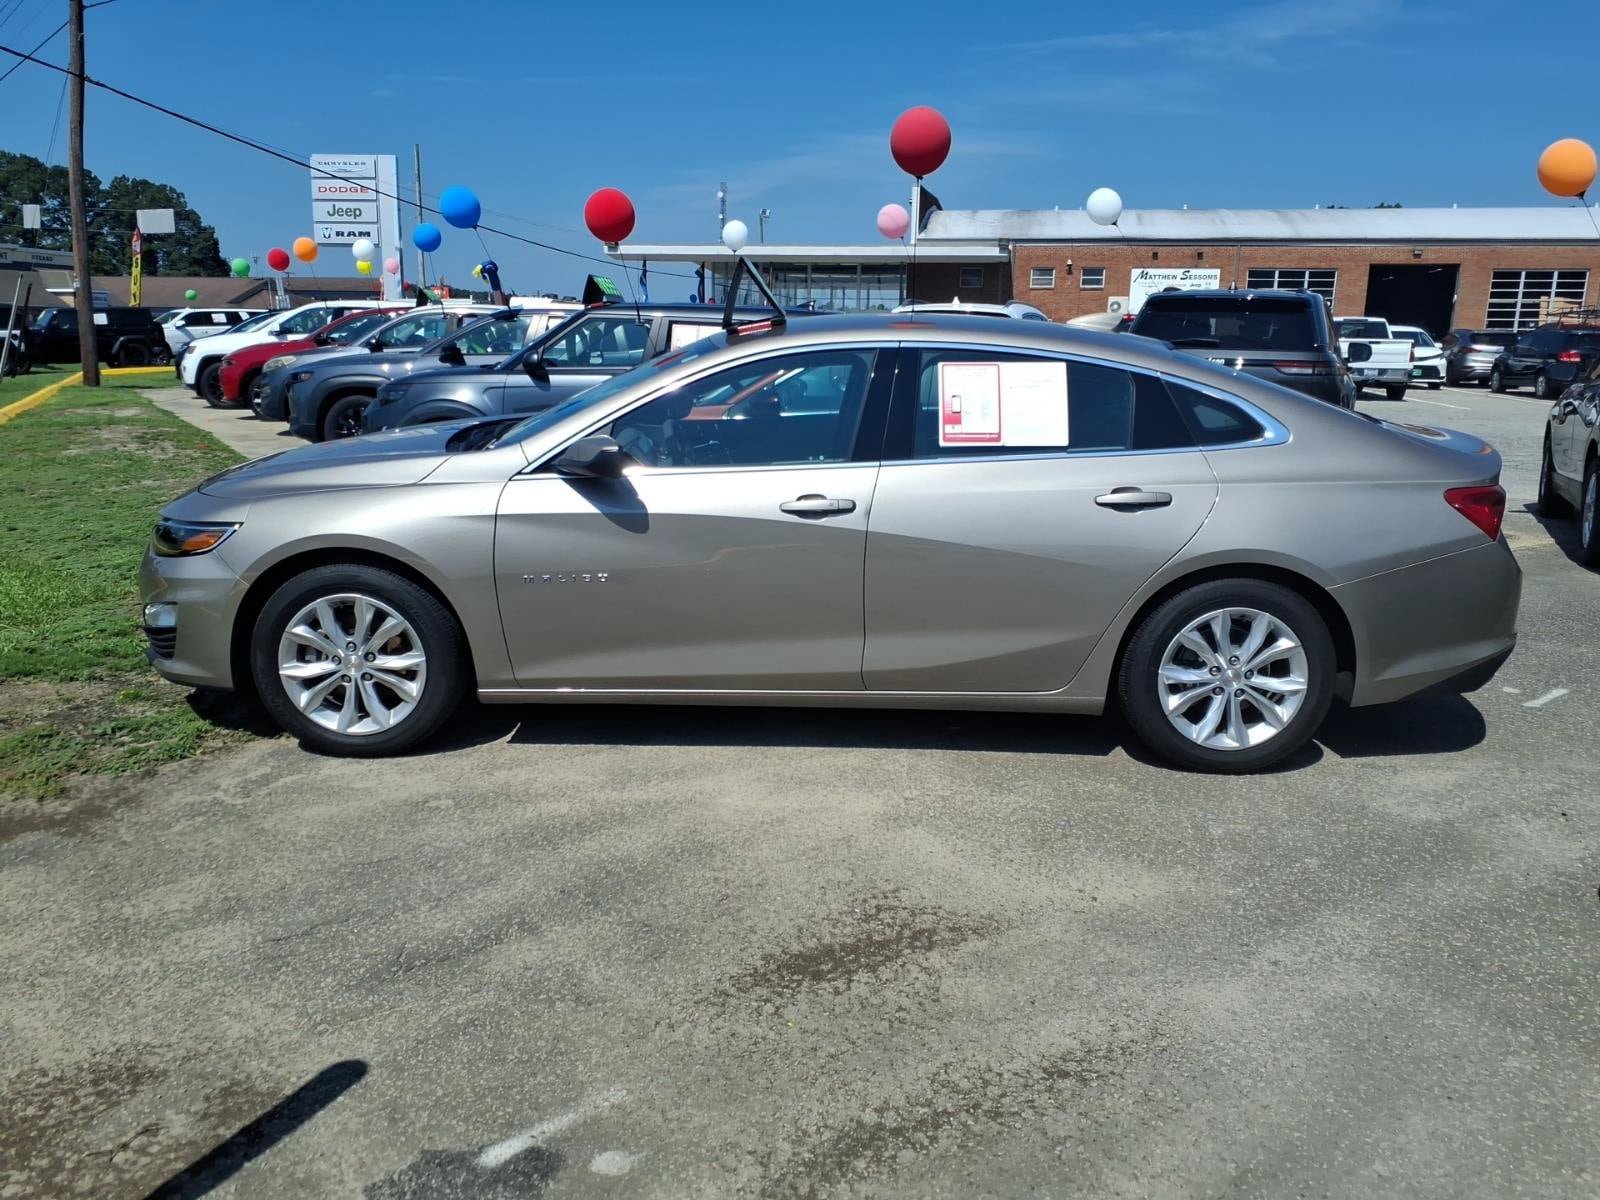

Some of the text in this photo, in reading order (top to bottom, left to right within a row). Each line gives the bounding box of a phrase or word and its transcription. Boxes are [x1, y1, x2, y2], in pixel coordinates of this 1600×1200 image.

[327, 203, 362, 219] Jeep
[1133, 270, 1218, 283] MATTHEW SESSOMS
[523, 573, 608, 583] MALIBU
